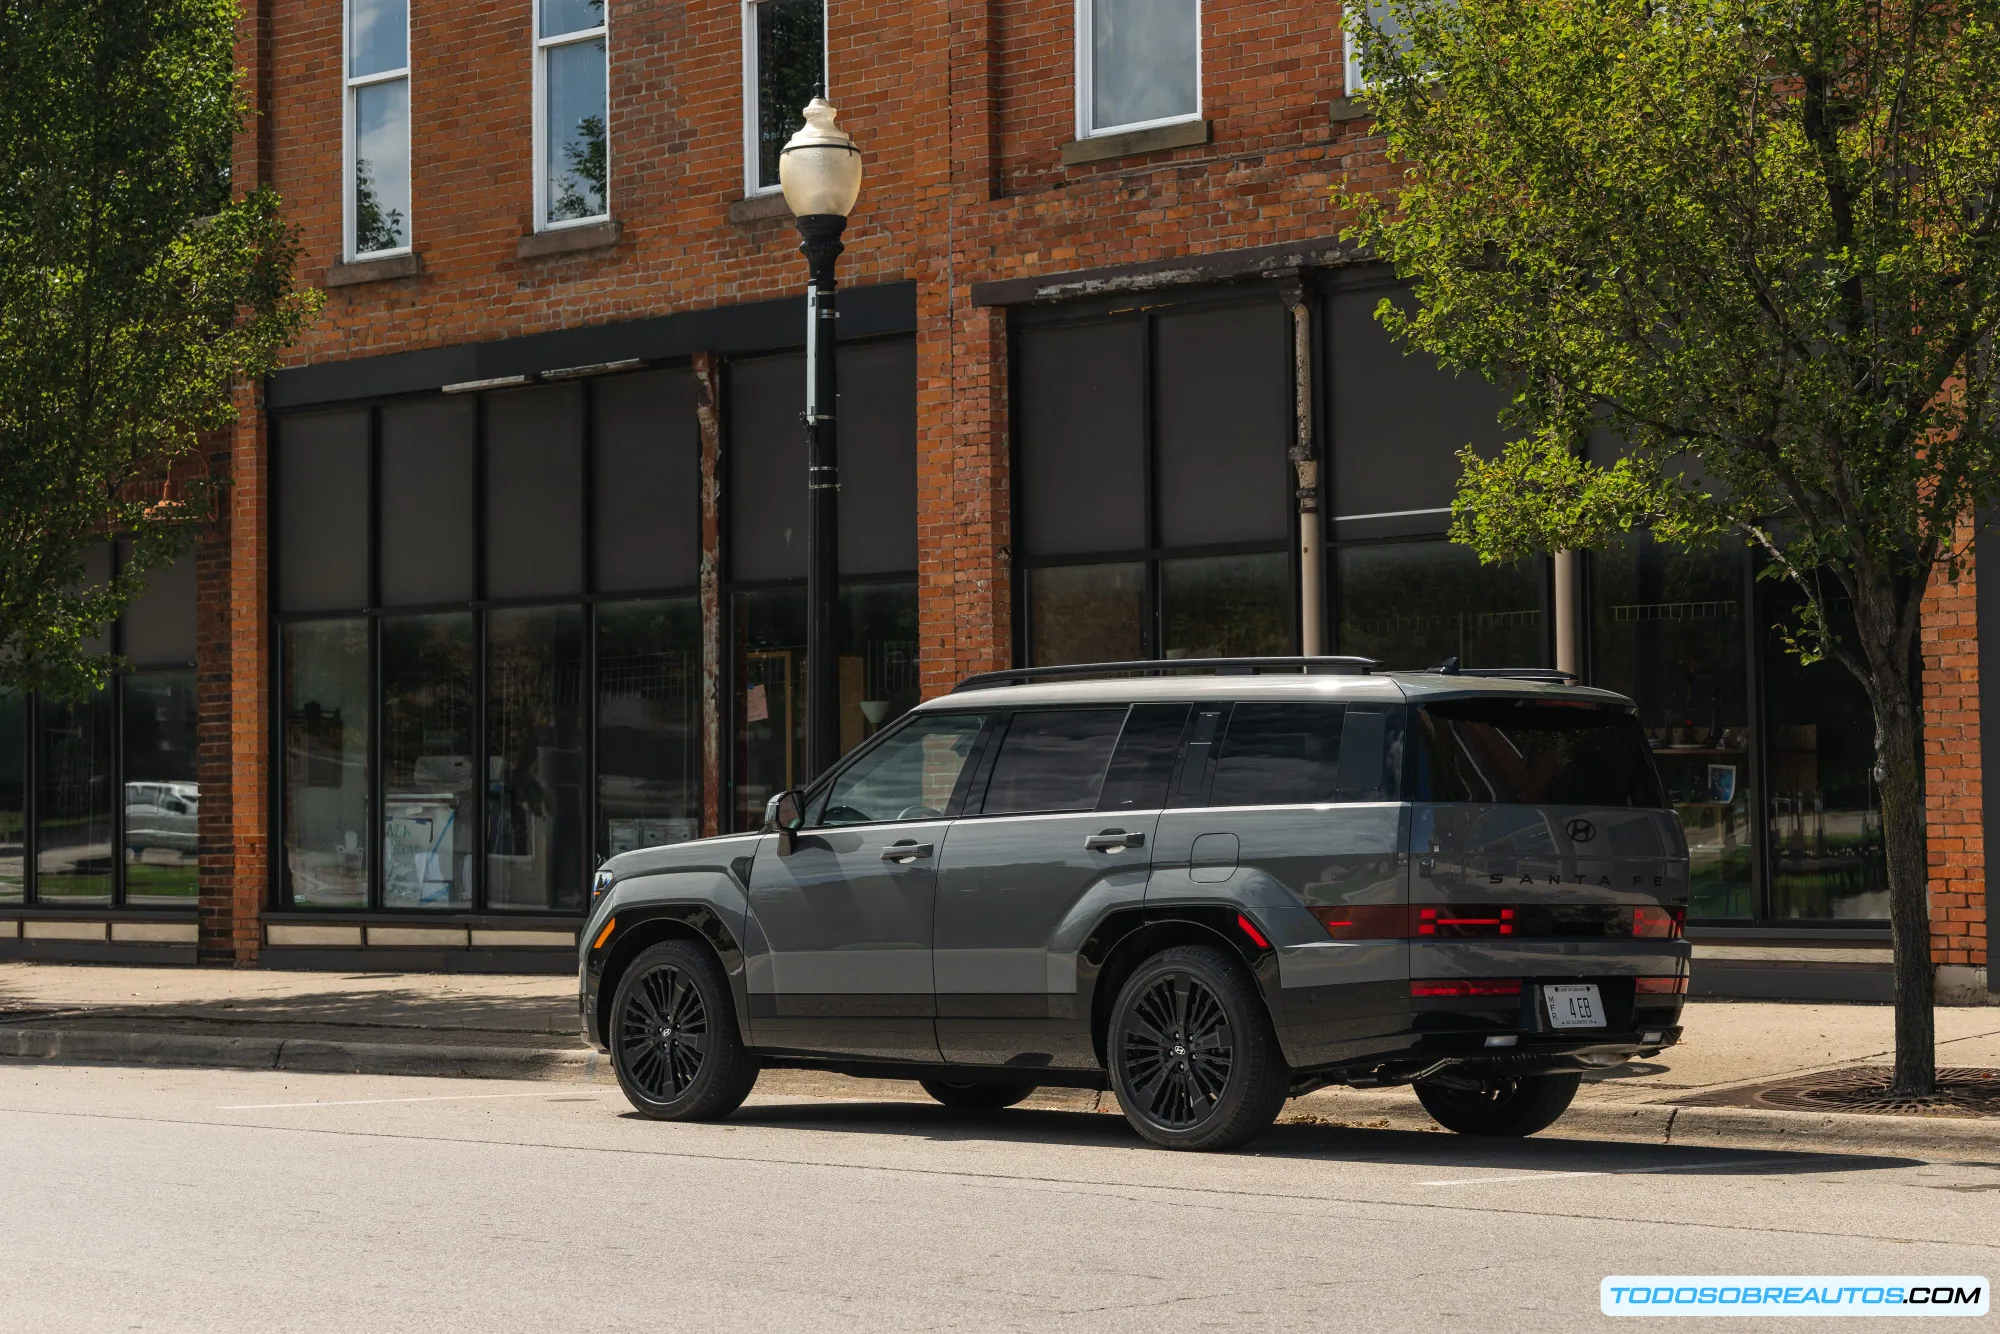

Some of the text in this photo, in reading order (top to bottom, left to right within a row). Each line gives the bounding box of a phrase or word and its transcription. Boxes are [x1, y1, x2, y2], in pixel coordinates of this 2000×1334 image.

[386, 824, 411, 837] NEW
[1489, 873, 1663, 887] SANTA FE
[1569, 997, 1592, 1018] 4 EB
